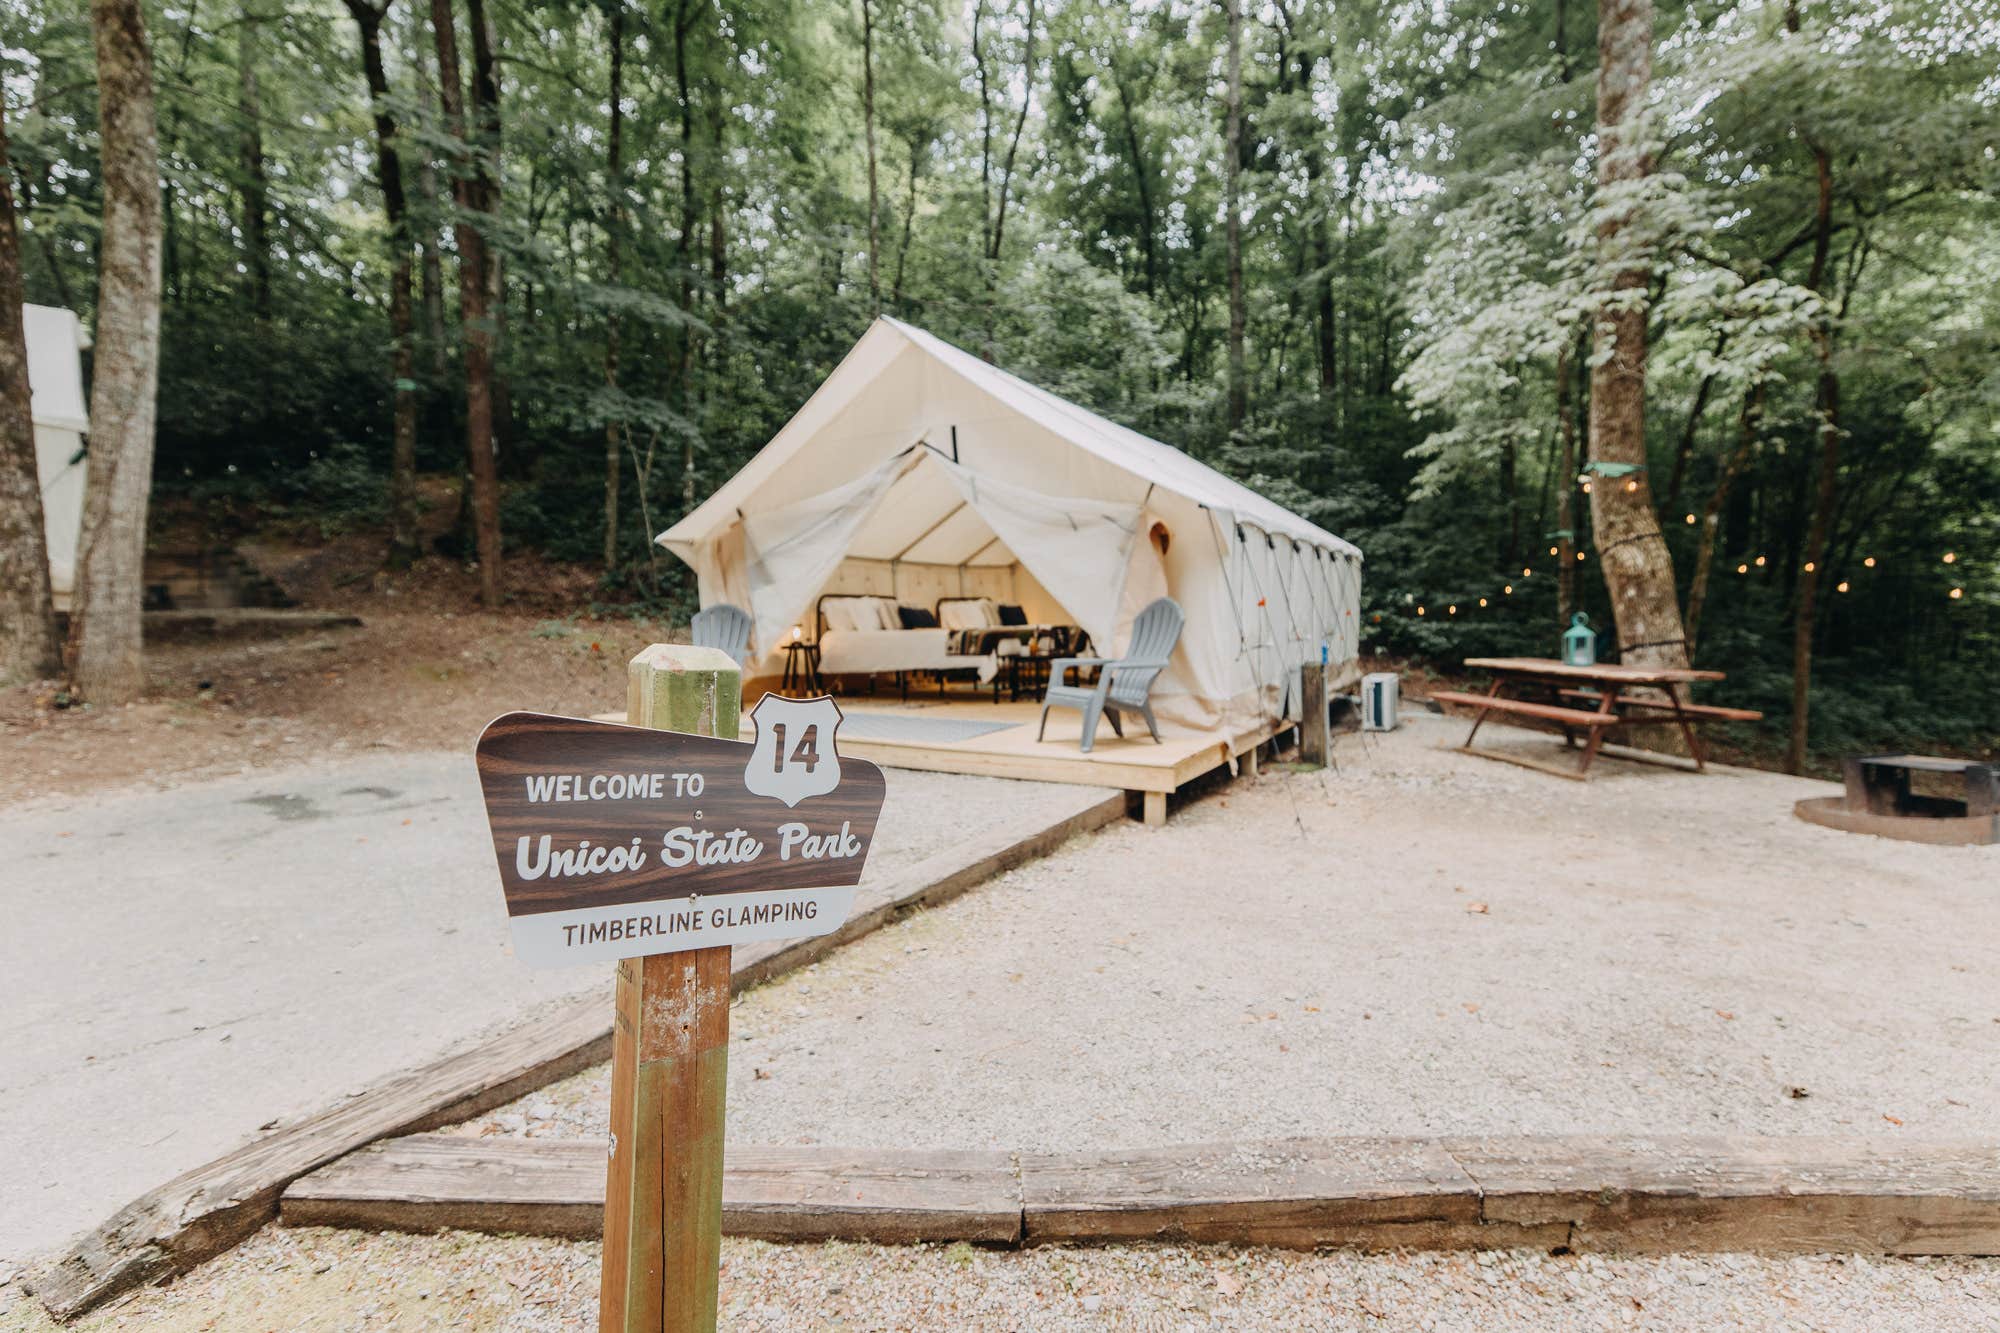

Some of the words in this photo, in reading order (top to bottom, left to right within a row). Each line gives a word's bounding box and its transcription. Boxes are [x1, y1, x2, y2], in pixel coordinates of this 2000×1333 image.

[772, 723, 820, 774] 14
[525, 774, 664, 803] WELCOME
[672, 773, 705, 798] TO
[515, 834, 647, 881] Unicoi
[660, 826, 764, 868] State
[777, 820, 862, 861] Park
[563, 910, 703, 947] TIMBERLINE
[711, 901, 818, 929] GLAMPING
